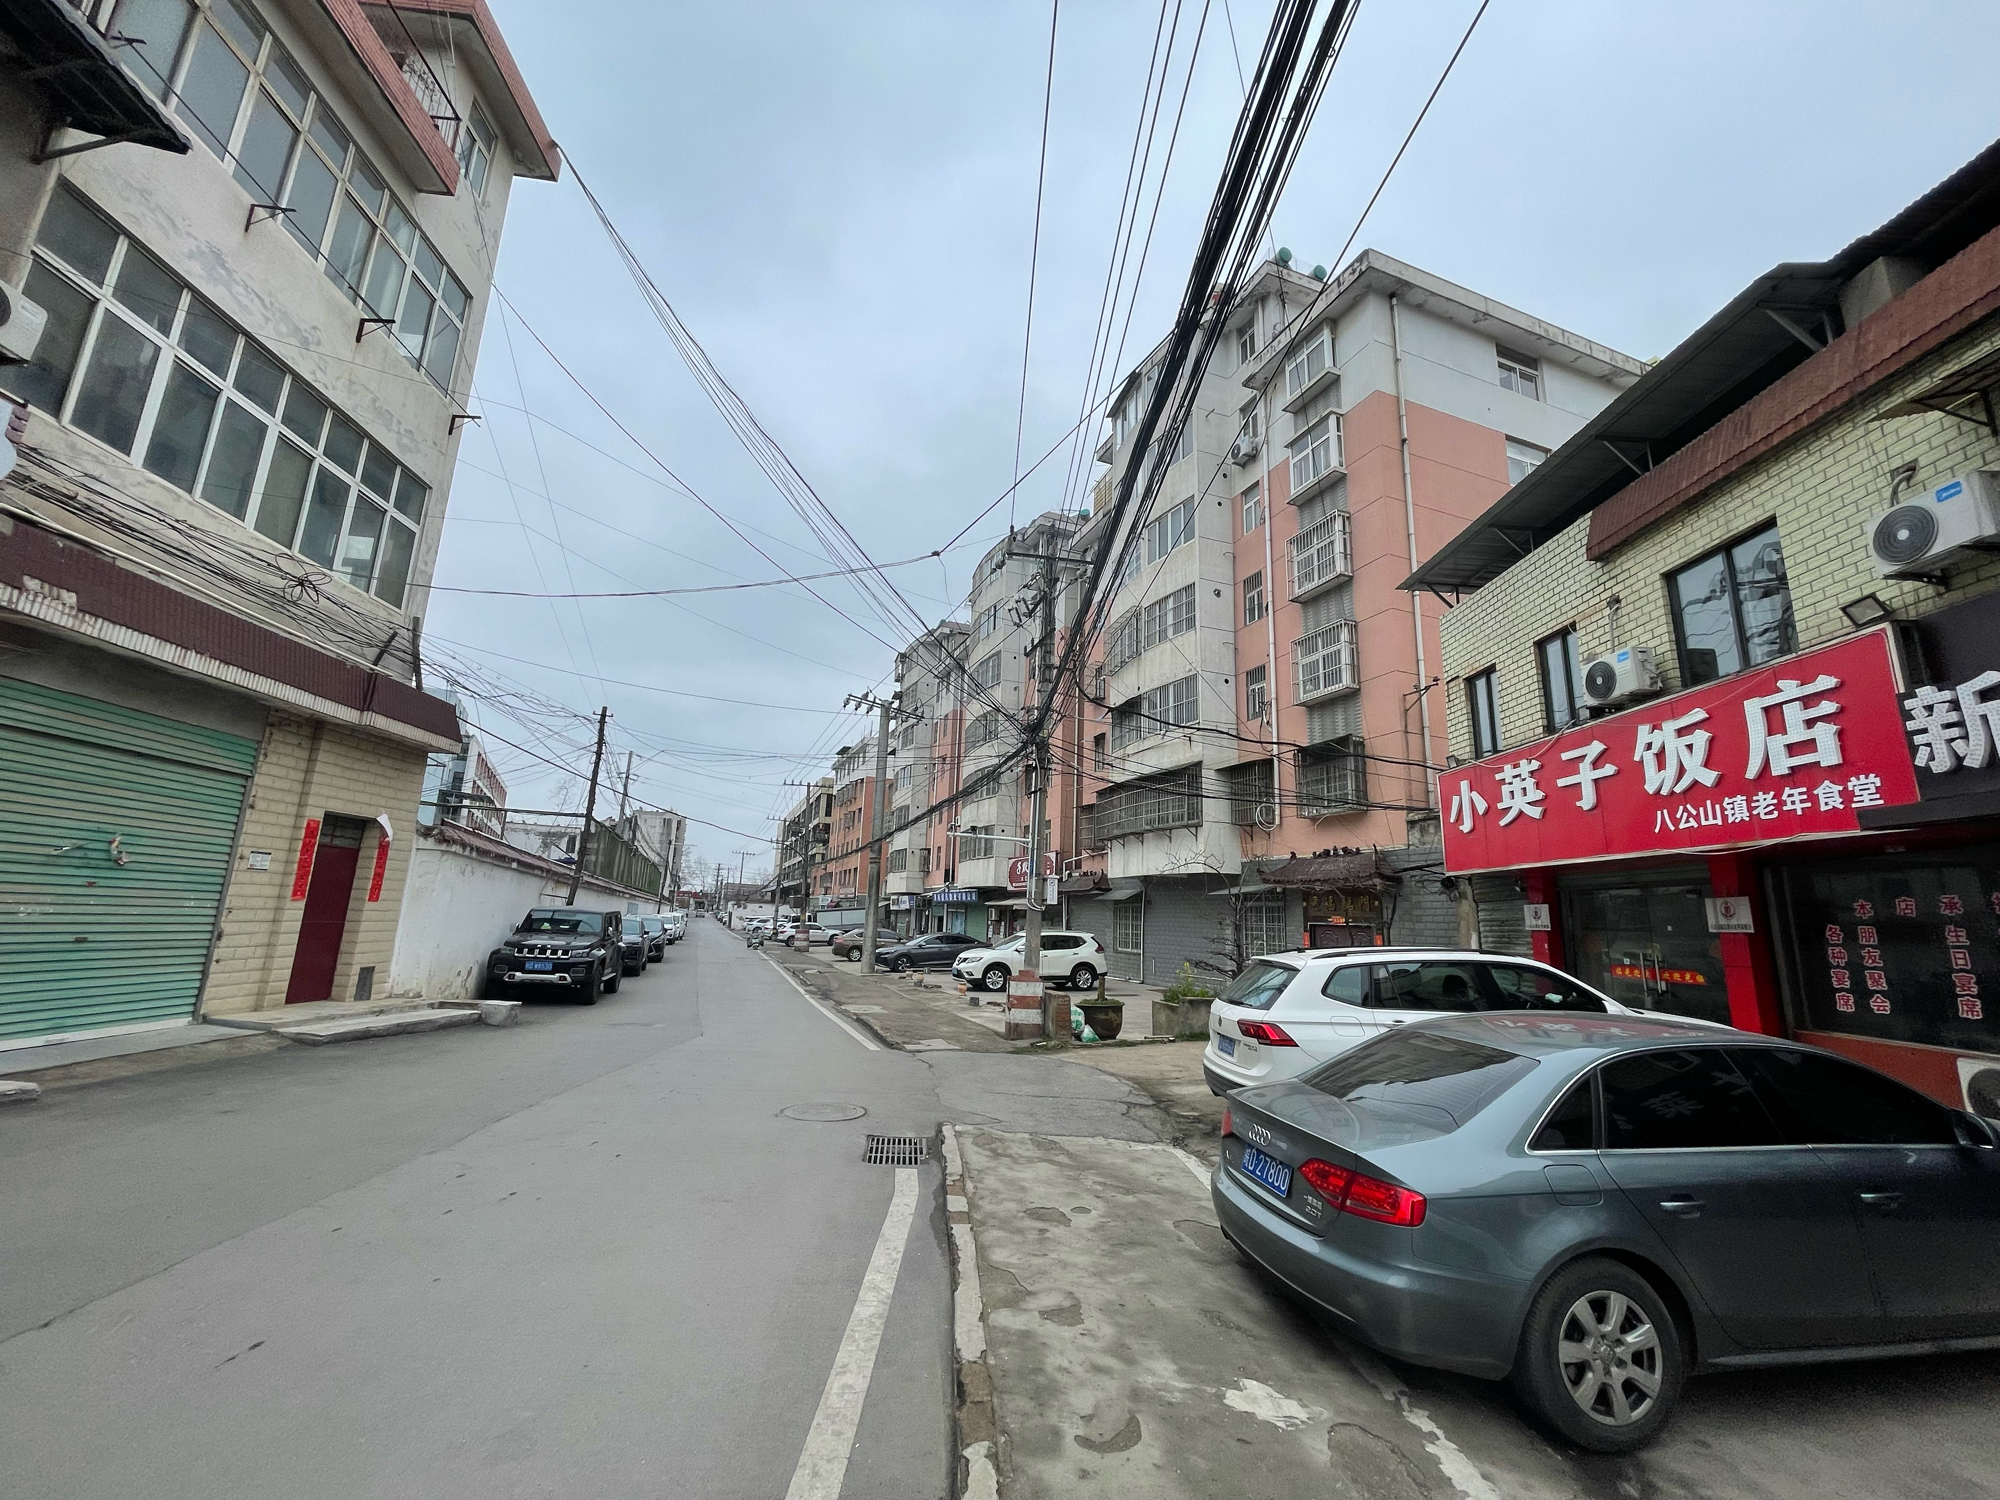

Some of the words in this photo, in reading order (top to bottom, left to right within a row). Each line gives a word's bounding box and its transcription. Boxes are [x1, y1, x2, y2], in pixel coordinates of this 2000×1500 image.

[1449, 674, 1841, 834] 小英子饭店
[1904, 670, 2000, 774] 新
[1653, 773, 1884, 834] 八公山镇老年食堂
[1825, 924, 1856, 1013] 各种宴席
[1857, 925, 1891, 1014] 朋友聚会
[1944, 925, 1983, 1020] 生日宴席
